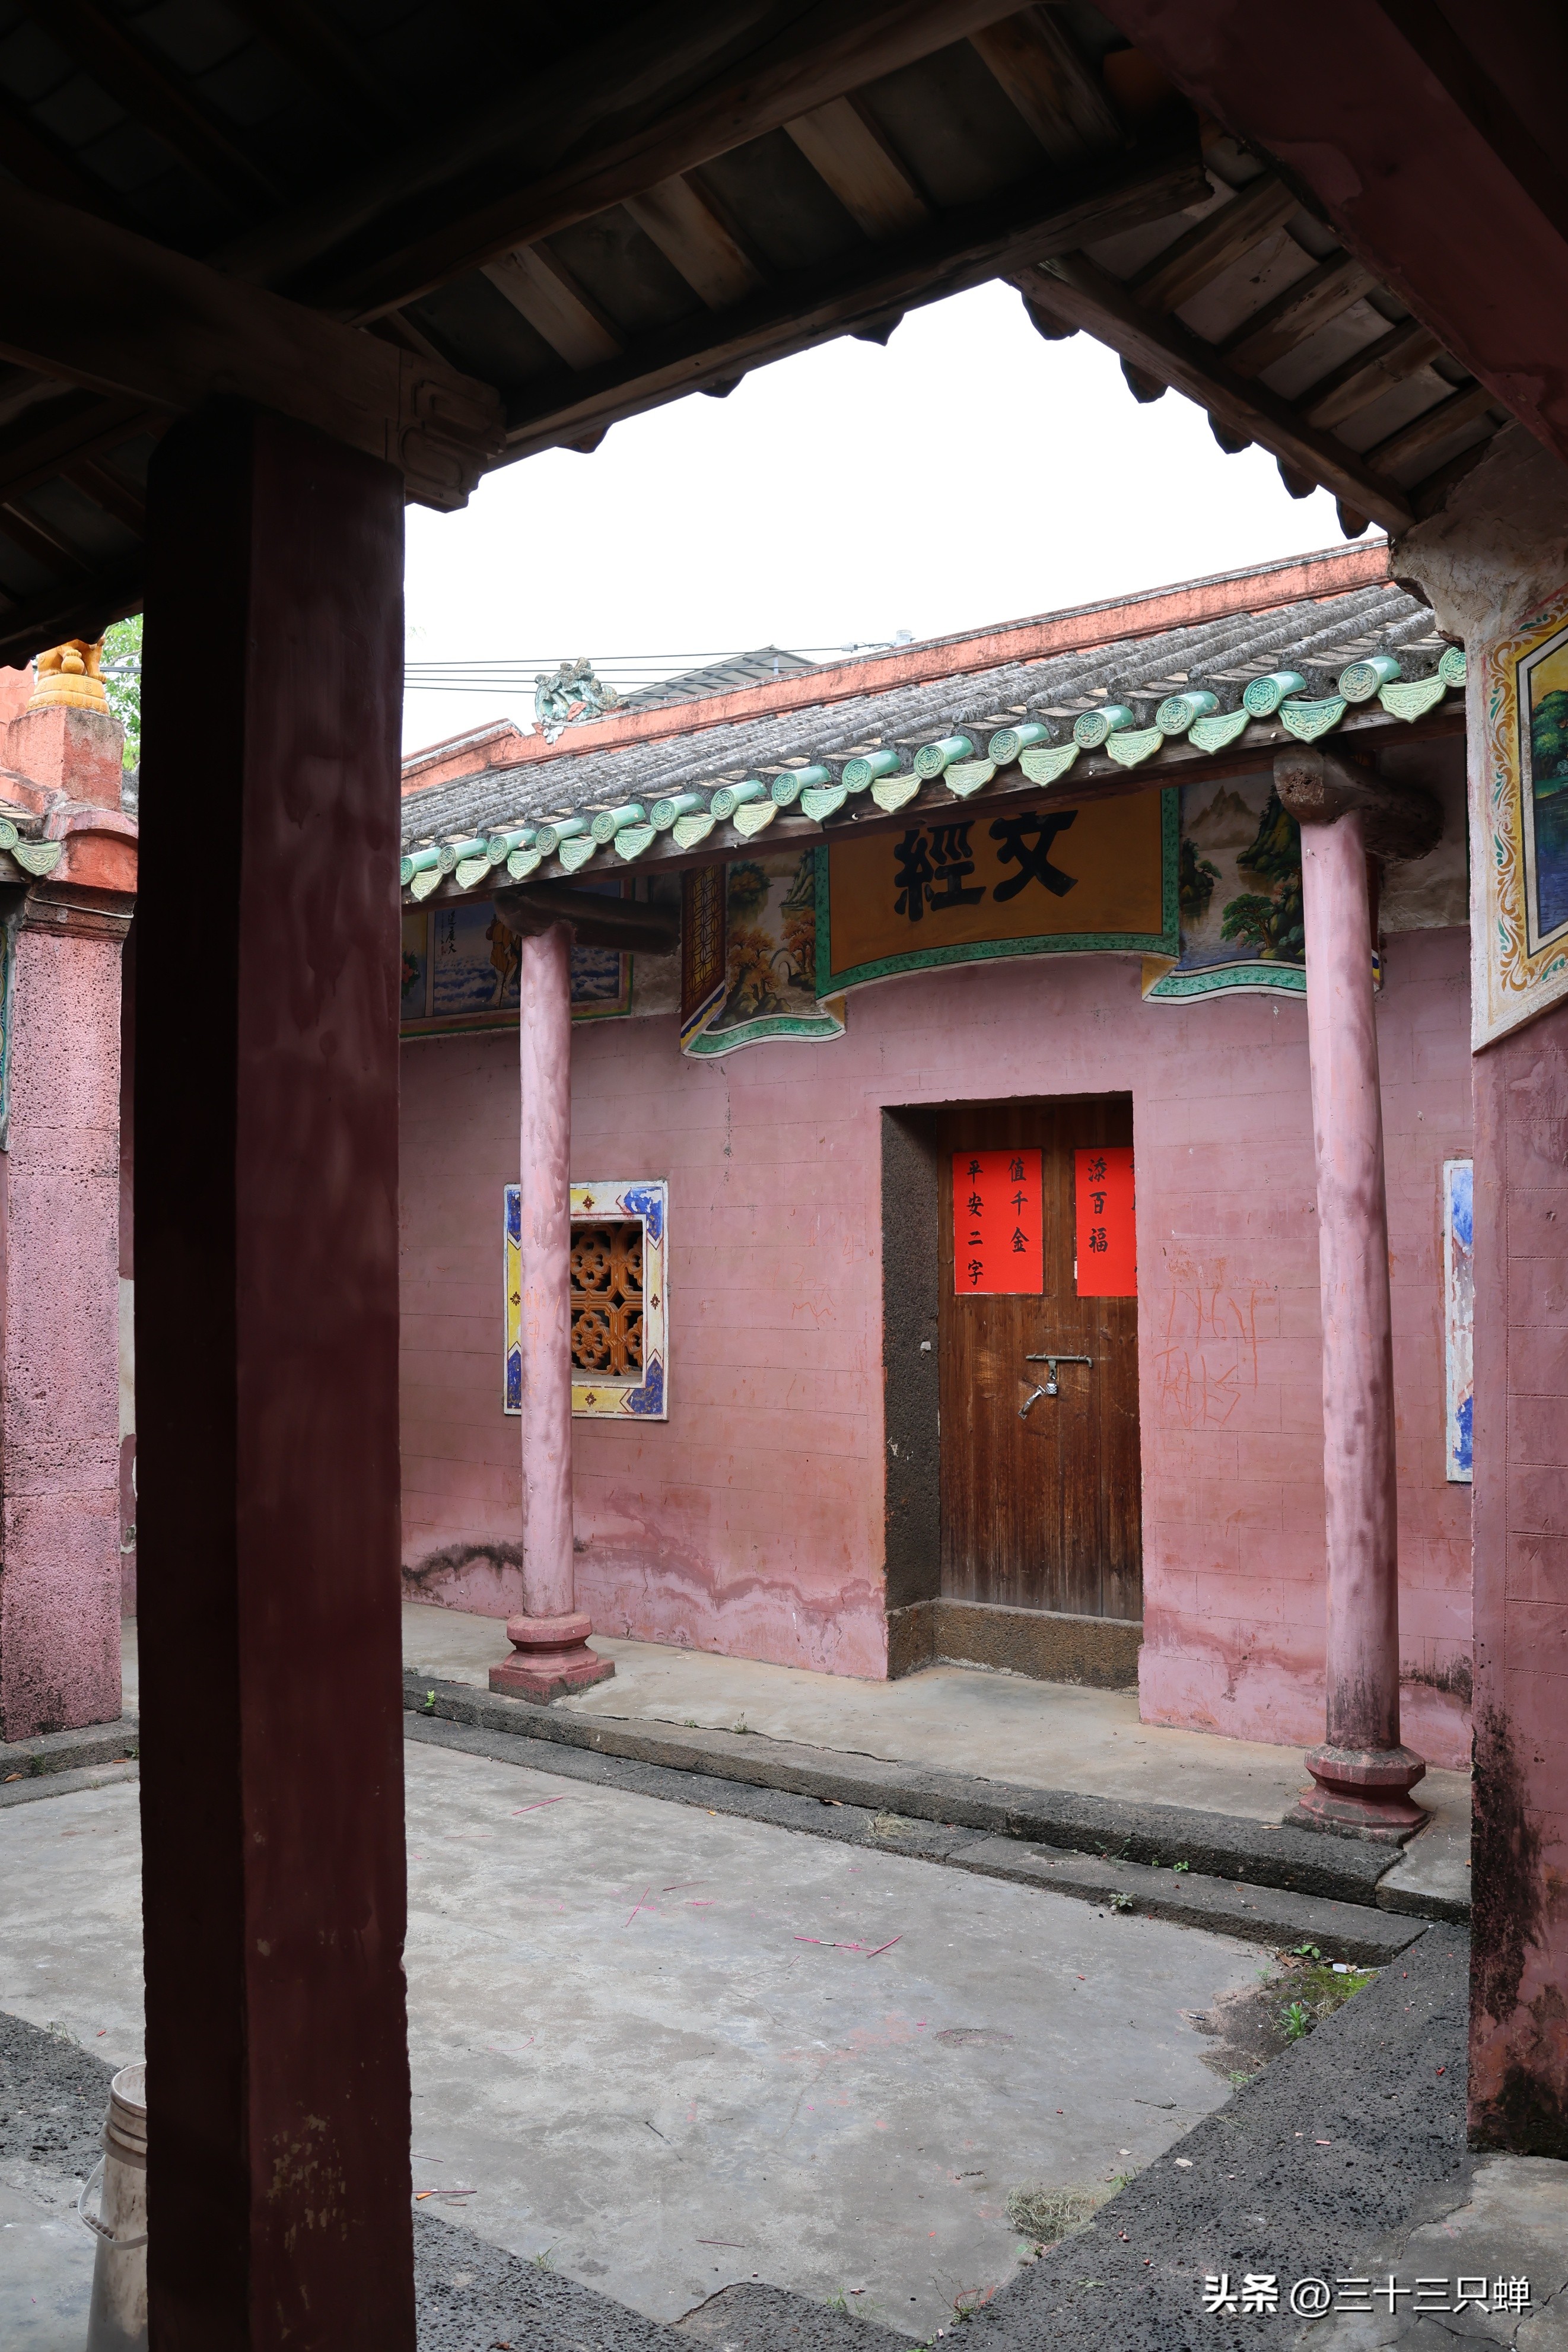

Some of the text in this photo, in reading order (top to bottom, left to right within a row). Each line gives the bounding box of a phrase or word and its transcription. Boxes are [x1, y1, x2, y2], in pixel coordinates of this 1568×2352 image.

[966, 1159, 984, 1286] 平安二字
[1009, 1156, 1030, 1253] 值千金
[1087, 1156, 1109, 1254] 添百福
